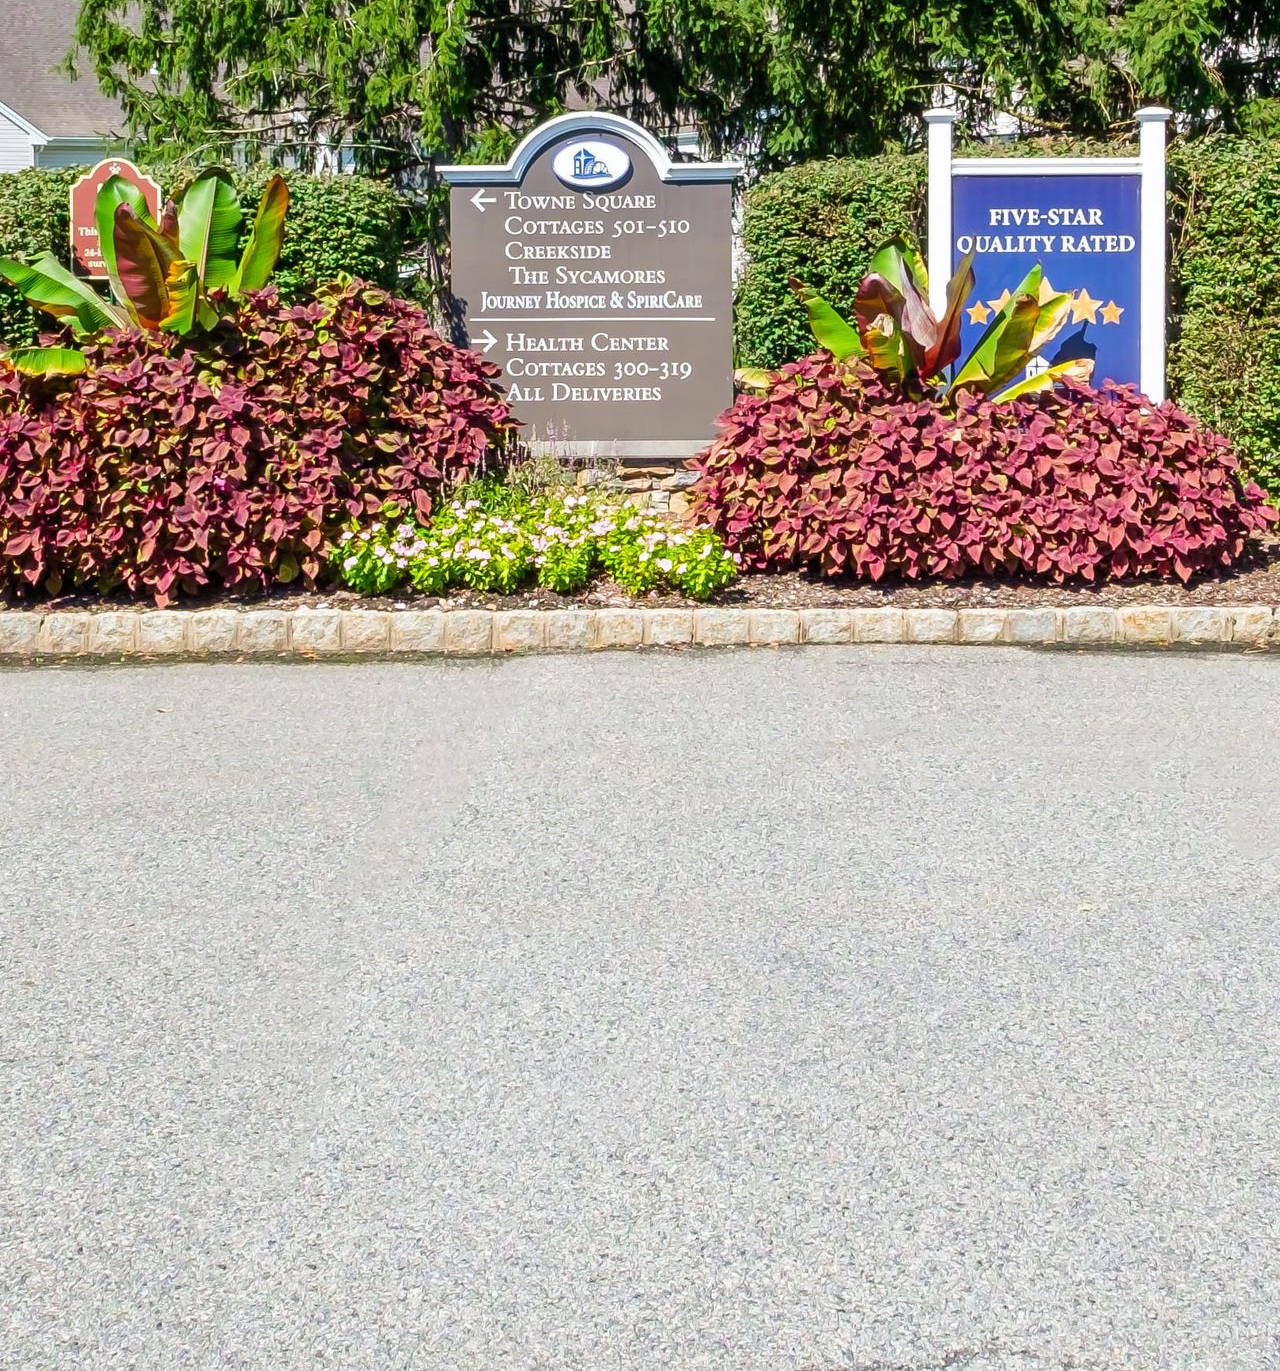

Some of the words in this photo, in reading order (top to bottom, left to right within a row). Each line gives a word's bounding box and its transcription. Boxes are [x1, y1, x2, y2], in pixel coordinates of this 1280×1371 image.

[504, 192, 576, 210] TOWNE
[583, 192, 656, 212] SQUARE
[505, 216, 604, 235] COTTAGES
[989, 209, 1103, 226] FIVE-STAR
[505, 242, 611, 260] CREEKSIDE
[957, 235, 1056, 254] QUALITY
[1061, 235, 1135, 253] RATED
[509, 267, 549, 285] THE
[556, 266, 665, 285] SYCAMORES
[481, 292, 541, 312] JOURNEY
[546, 291, 606, 309] HOSPICE
[610, 291, 624, 309] &
[506, 334, 584, 351] HEALTH
[591, 333, 669, 351] CENTER
[506, 358, 605, 377] COTTAGES
[506, 383, 544, 401] ALL
[552, 383, 661, 401] DELIVERIES
